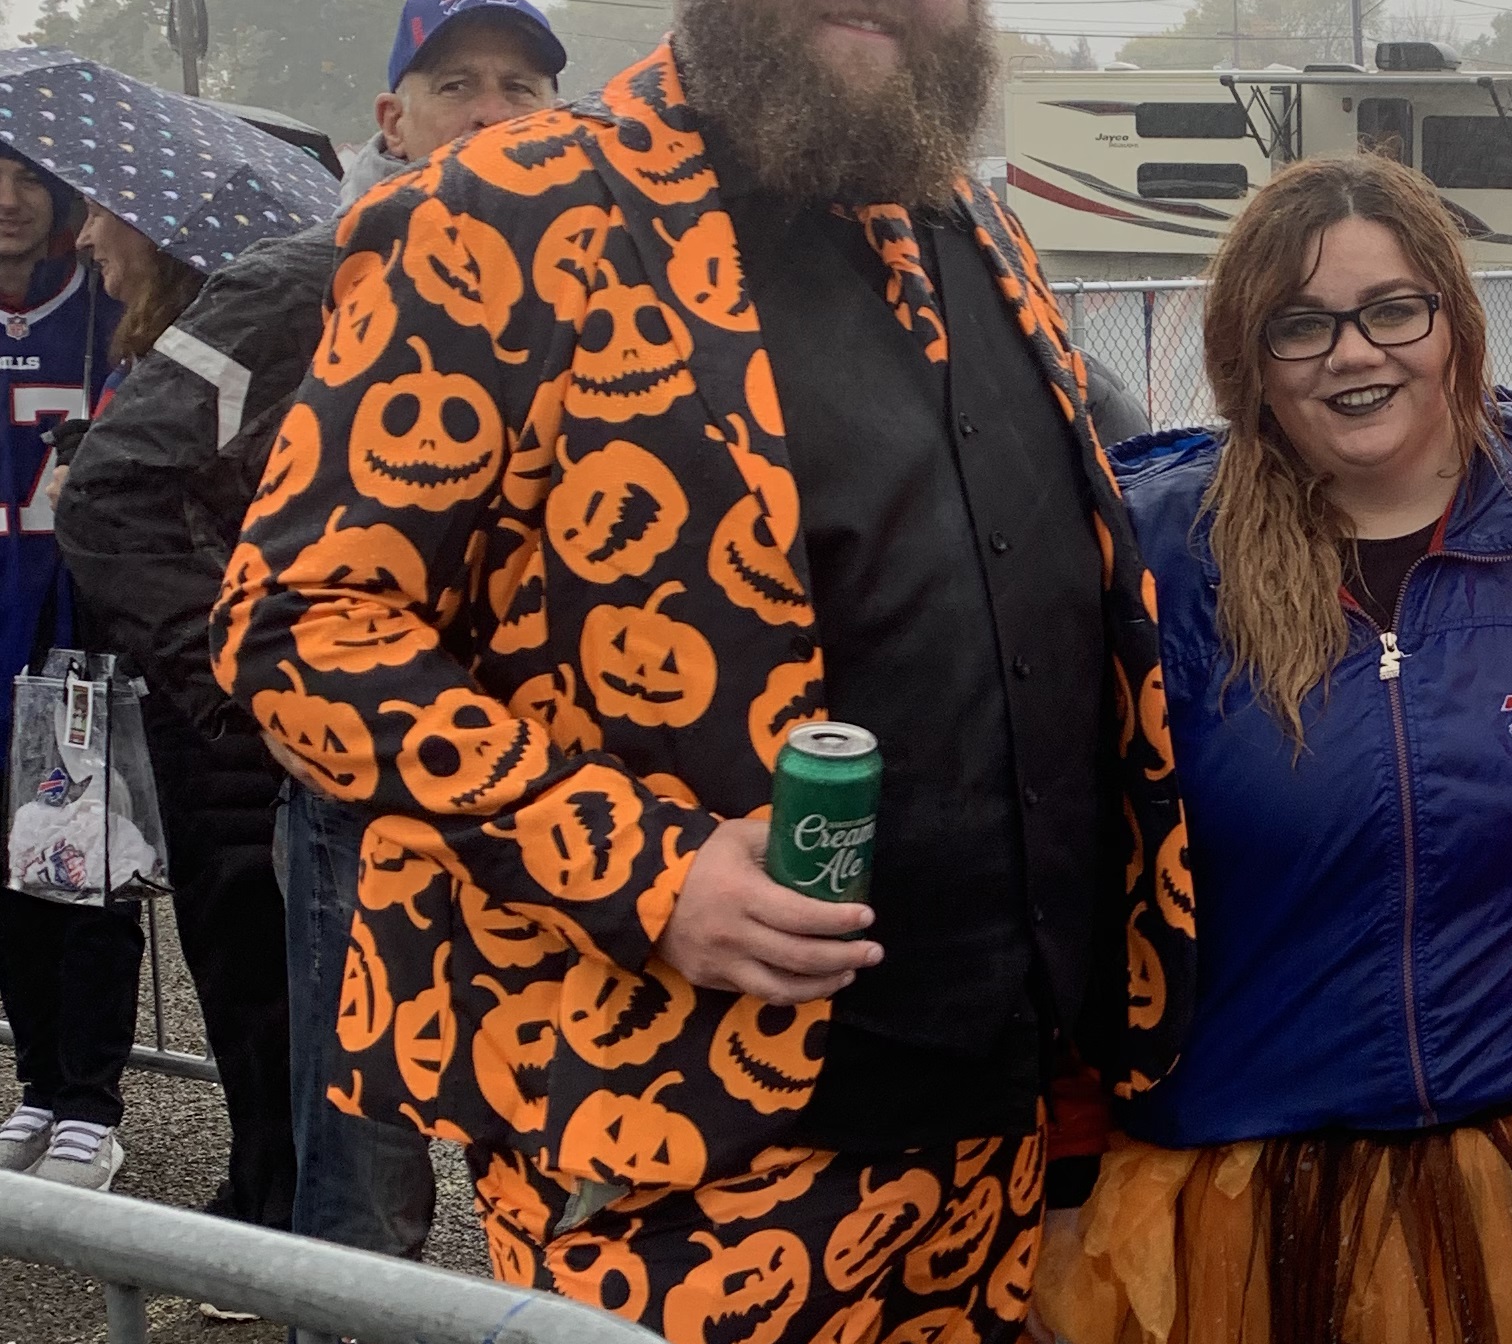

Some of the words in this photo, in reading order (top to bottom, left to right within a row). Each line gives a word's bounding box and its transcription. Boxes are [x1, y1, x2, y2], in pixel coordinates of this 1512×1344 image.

[1095, 133, 1129, 143] Jayco
[0, 356, 40, 369] ILLS
[794, 848, 864, 893] Ale
